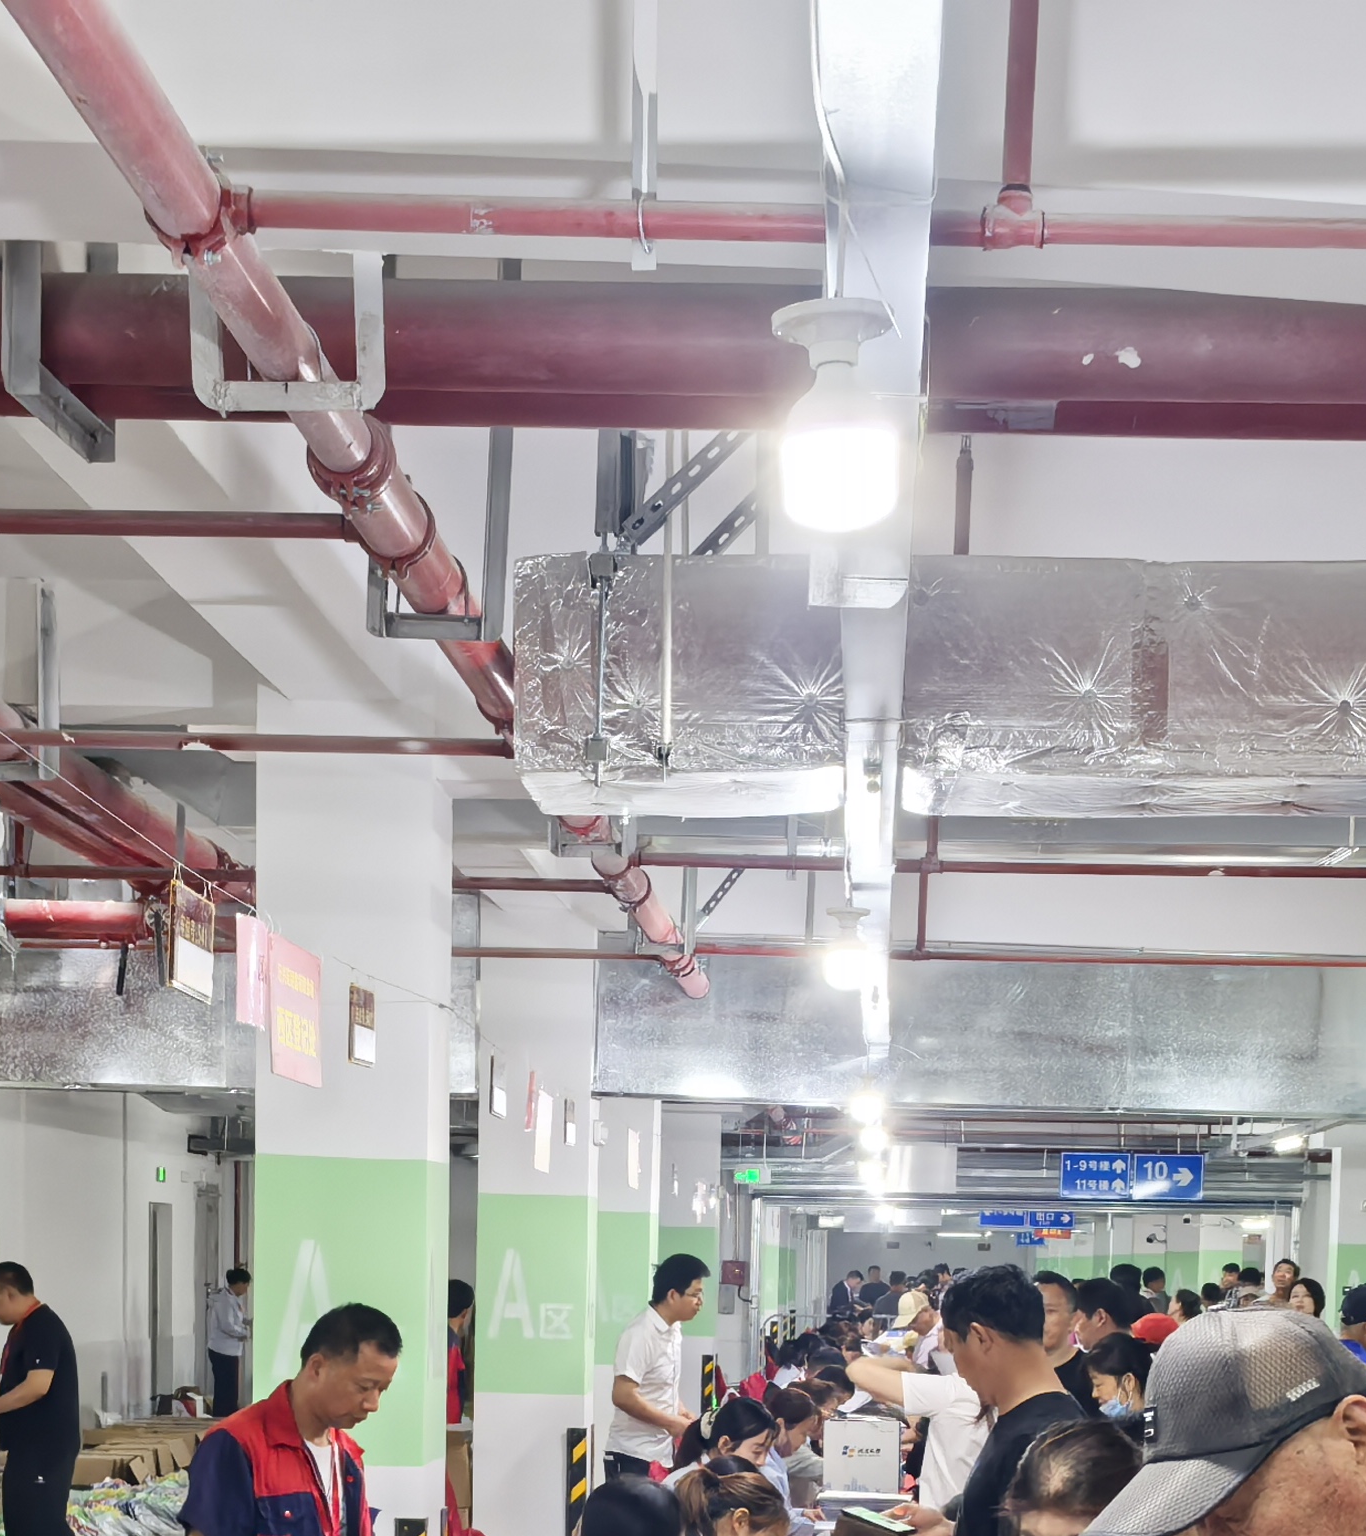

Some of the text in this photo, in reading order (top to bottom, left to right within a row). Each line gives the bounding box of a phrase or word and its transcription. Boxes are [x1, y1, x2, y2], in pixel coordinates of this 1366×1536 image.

[1064, 1159, 1111, 1172] 1-9号楼
[1143, 1161, 1168, 1180] 10
[1074, 1179, 1110, 1192] 11号楼
[487, 1248, 574, 1340] A区
